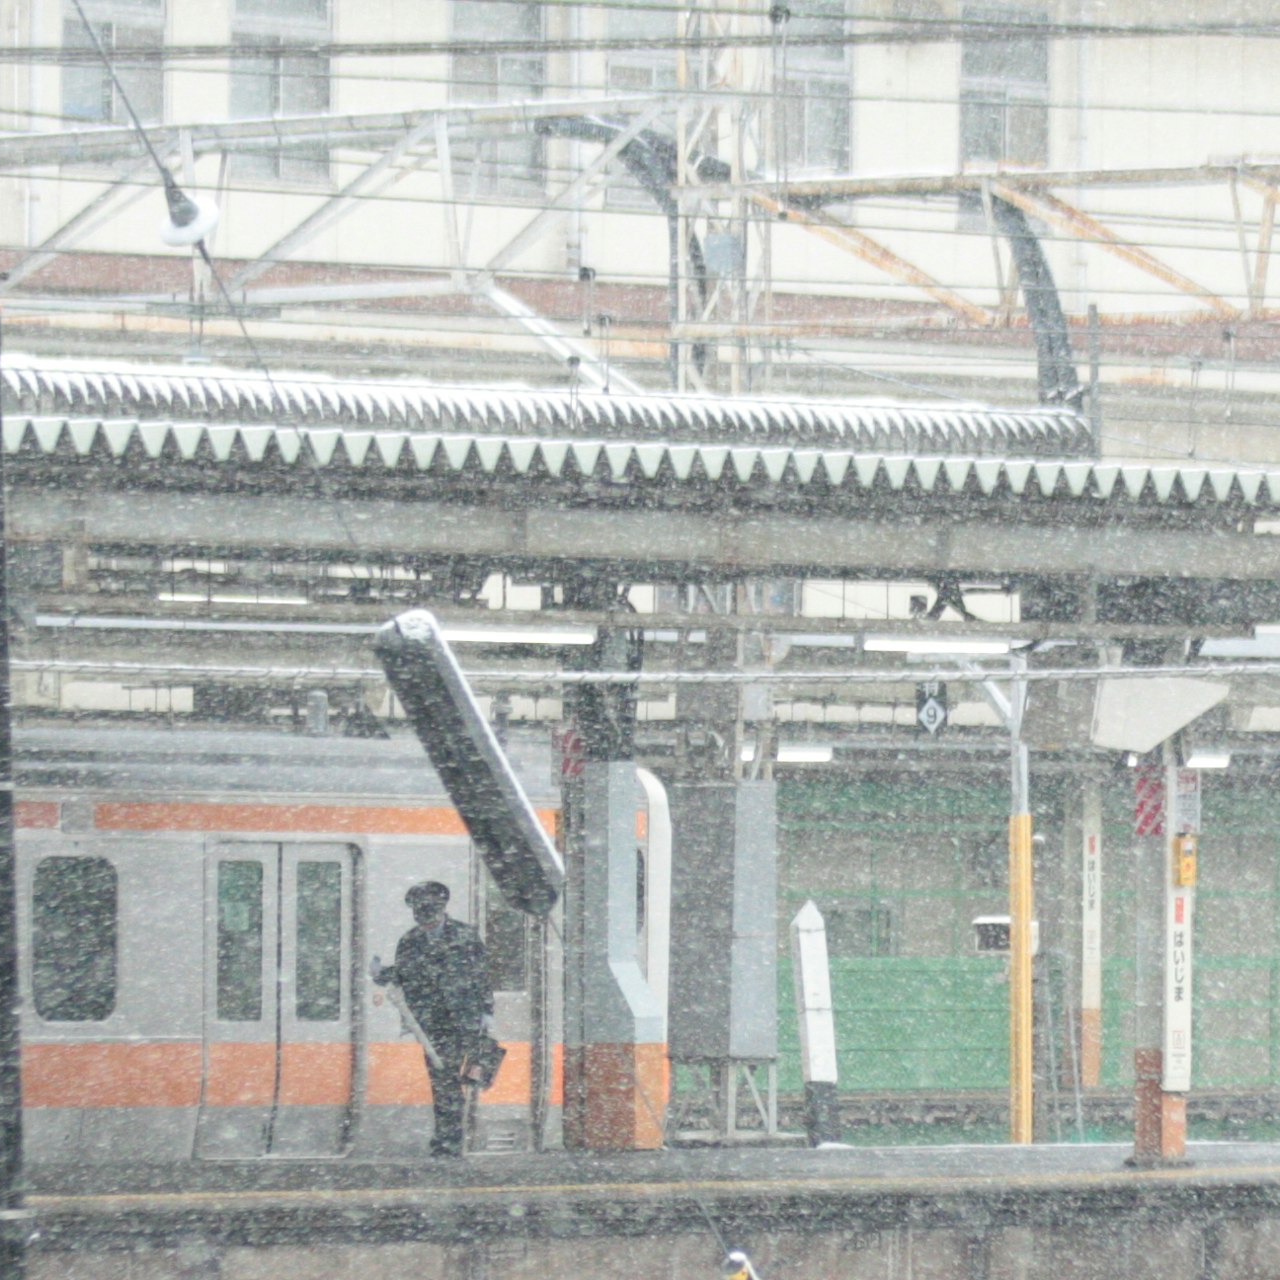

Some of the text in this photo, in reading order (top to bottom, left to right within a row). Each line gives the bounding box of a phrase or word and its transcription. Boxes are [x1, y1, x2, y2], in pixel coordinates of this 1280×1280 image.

[926, 707, 937, 725] 9
[1173, 931, 1185, 1002] はいじま
